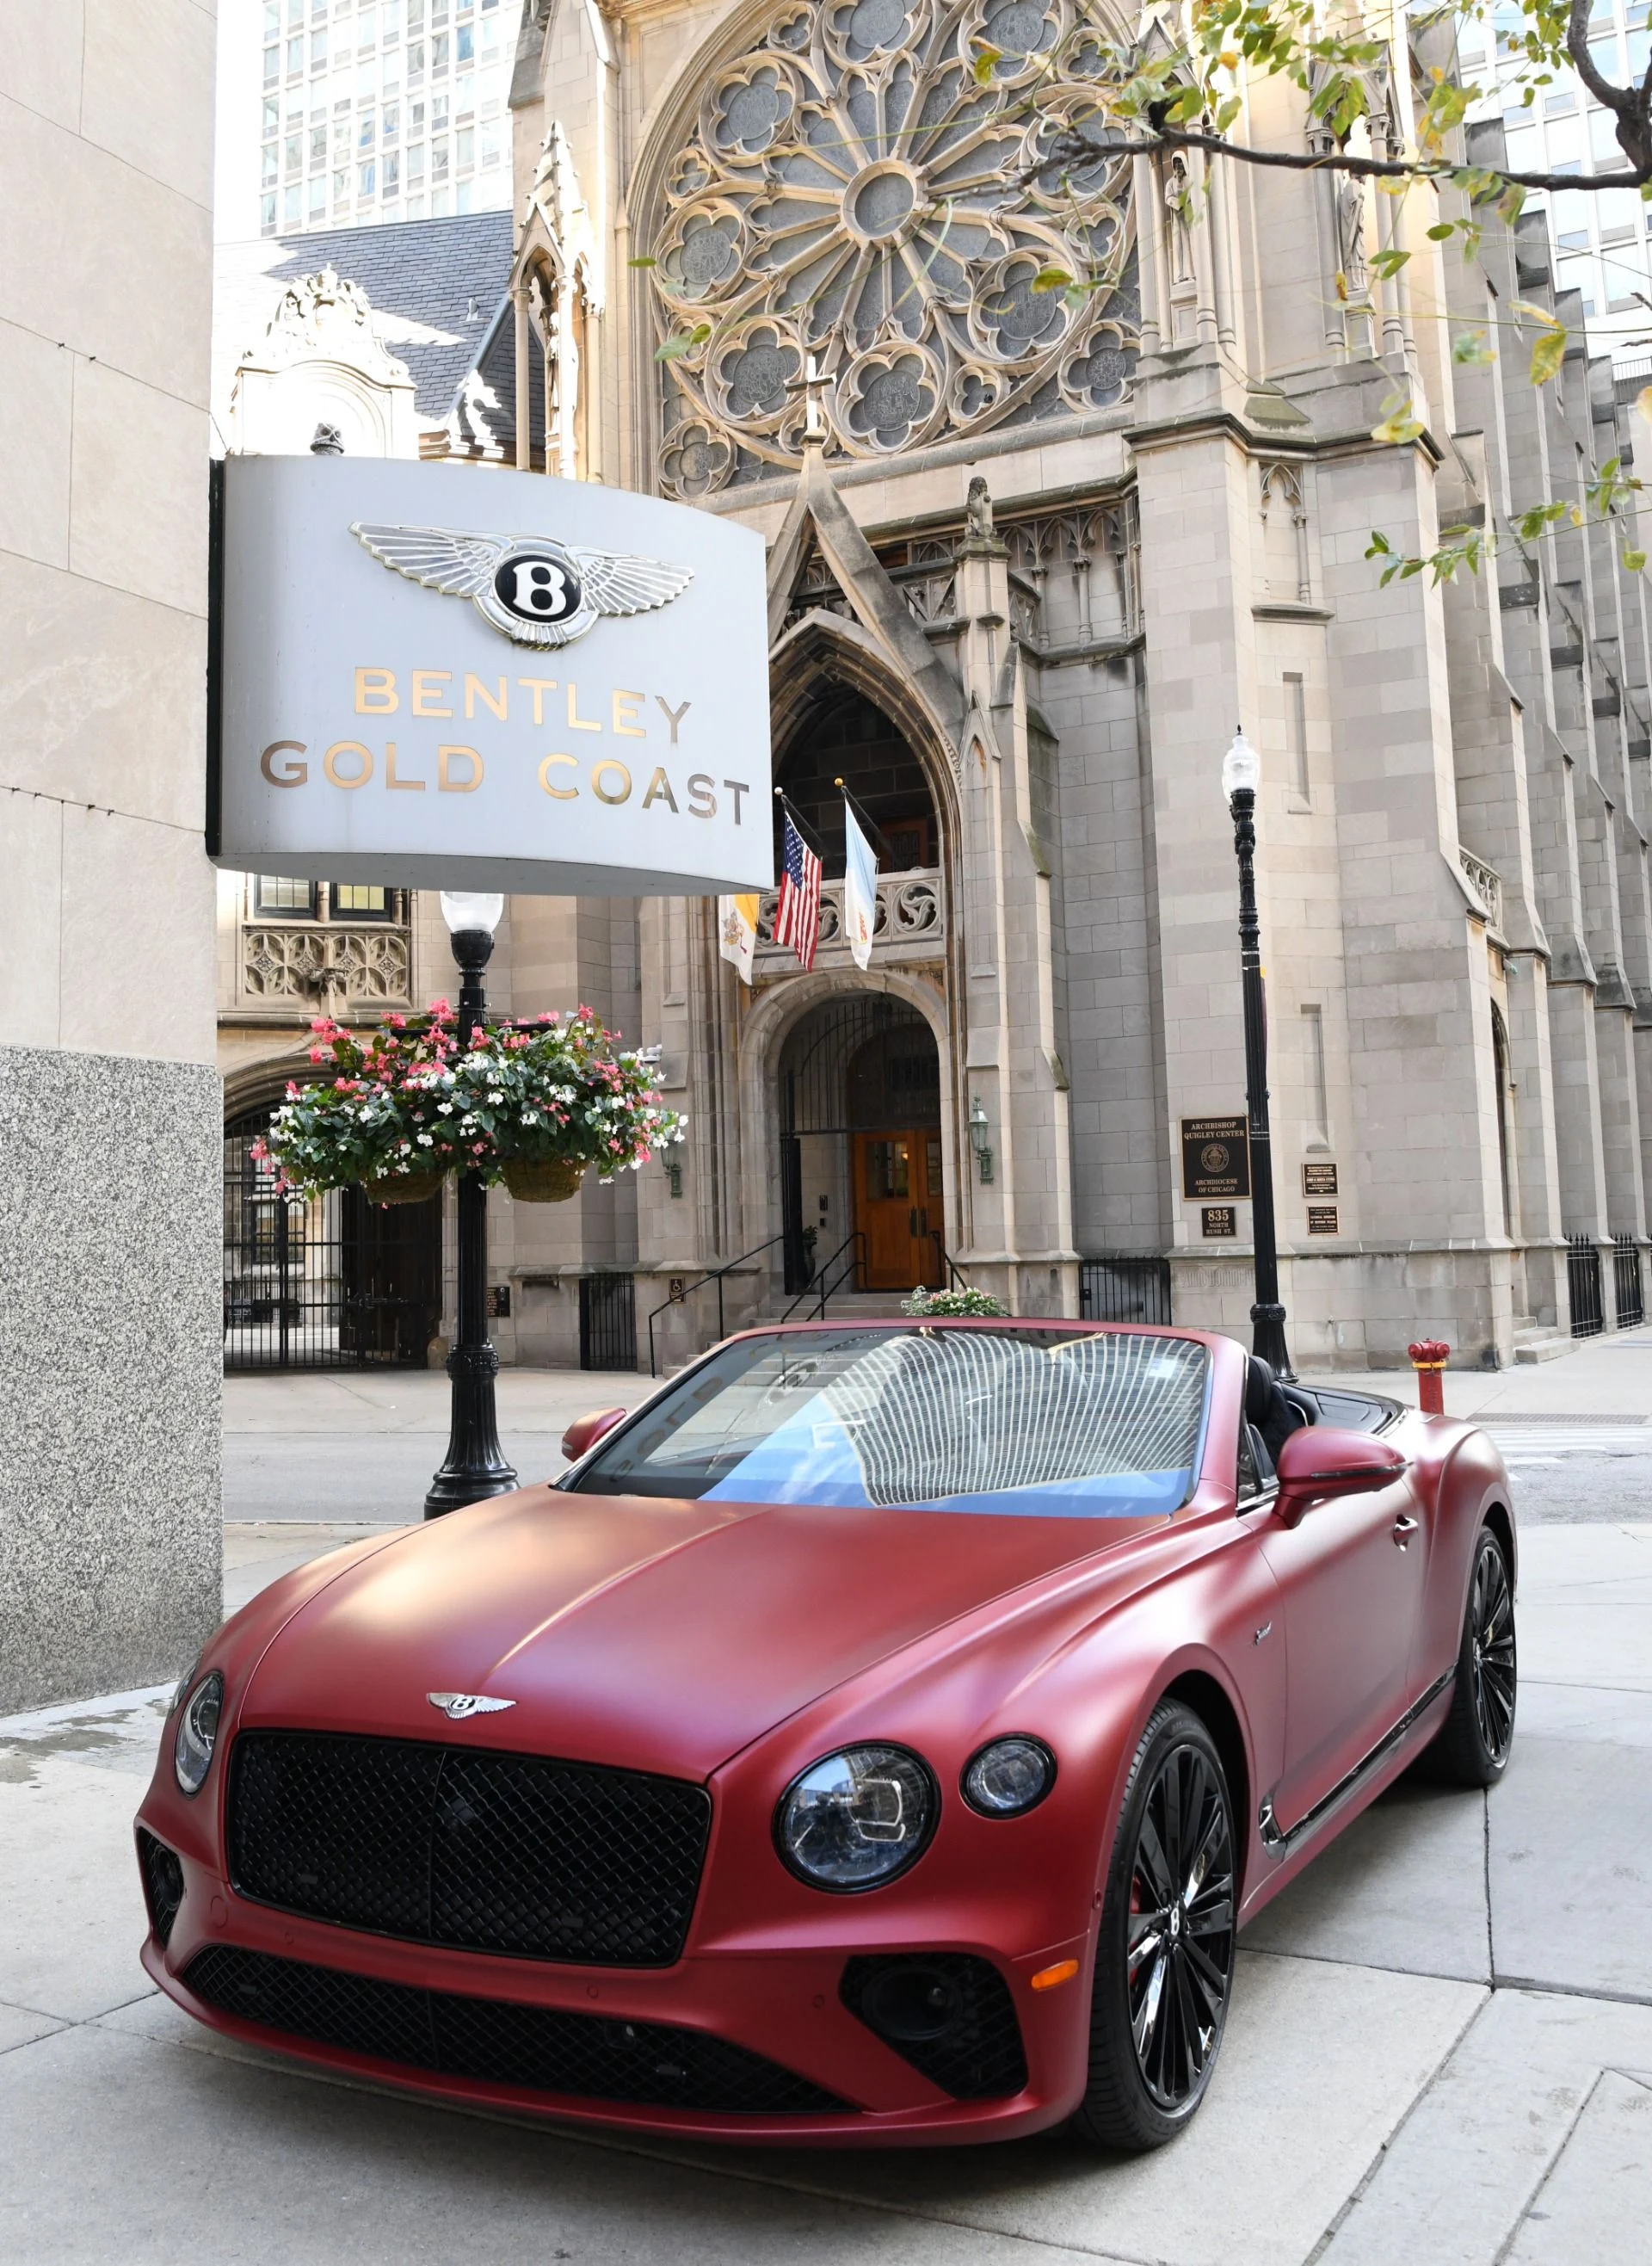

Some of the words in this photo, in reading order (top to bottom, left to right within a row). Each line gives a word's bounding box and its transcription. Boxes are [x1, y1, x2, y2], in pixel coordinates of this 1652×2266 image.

[512, 560, 567, 616] B
[354, 666, 692, 745] BENTLEY
[260, 739, 484, 793] GOLD
[537, 752, 750, 826] COAST
[1184, 1131, 1215, 1140] QUIGLEY
[1191, 1121, 1236, 1130] ARCHBISHOP
[1207, 1209, 1229, 1222] 835
